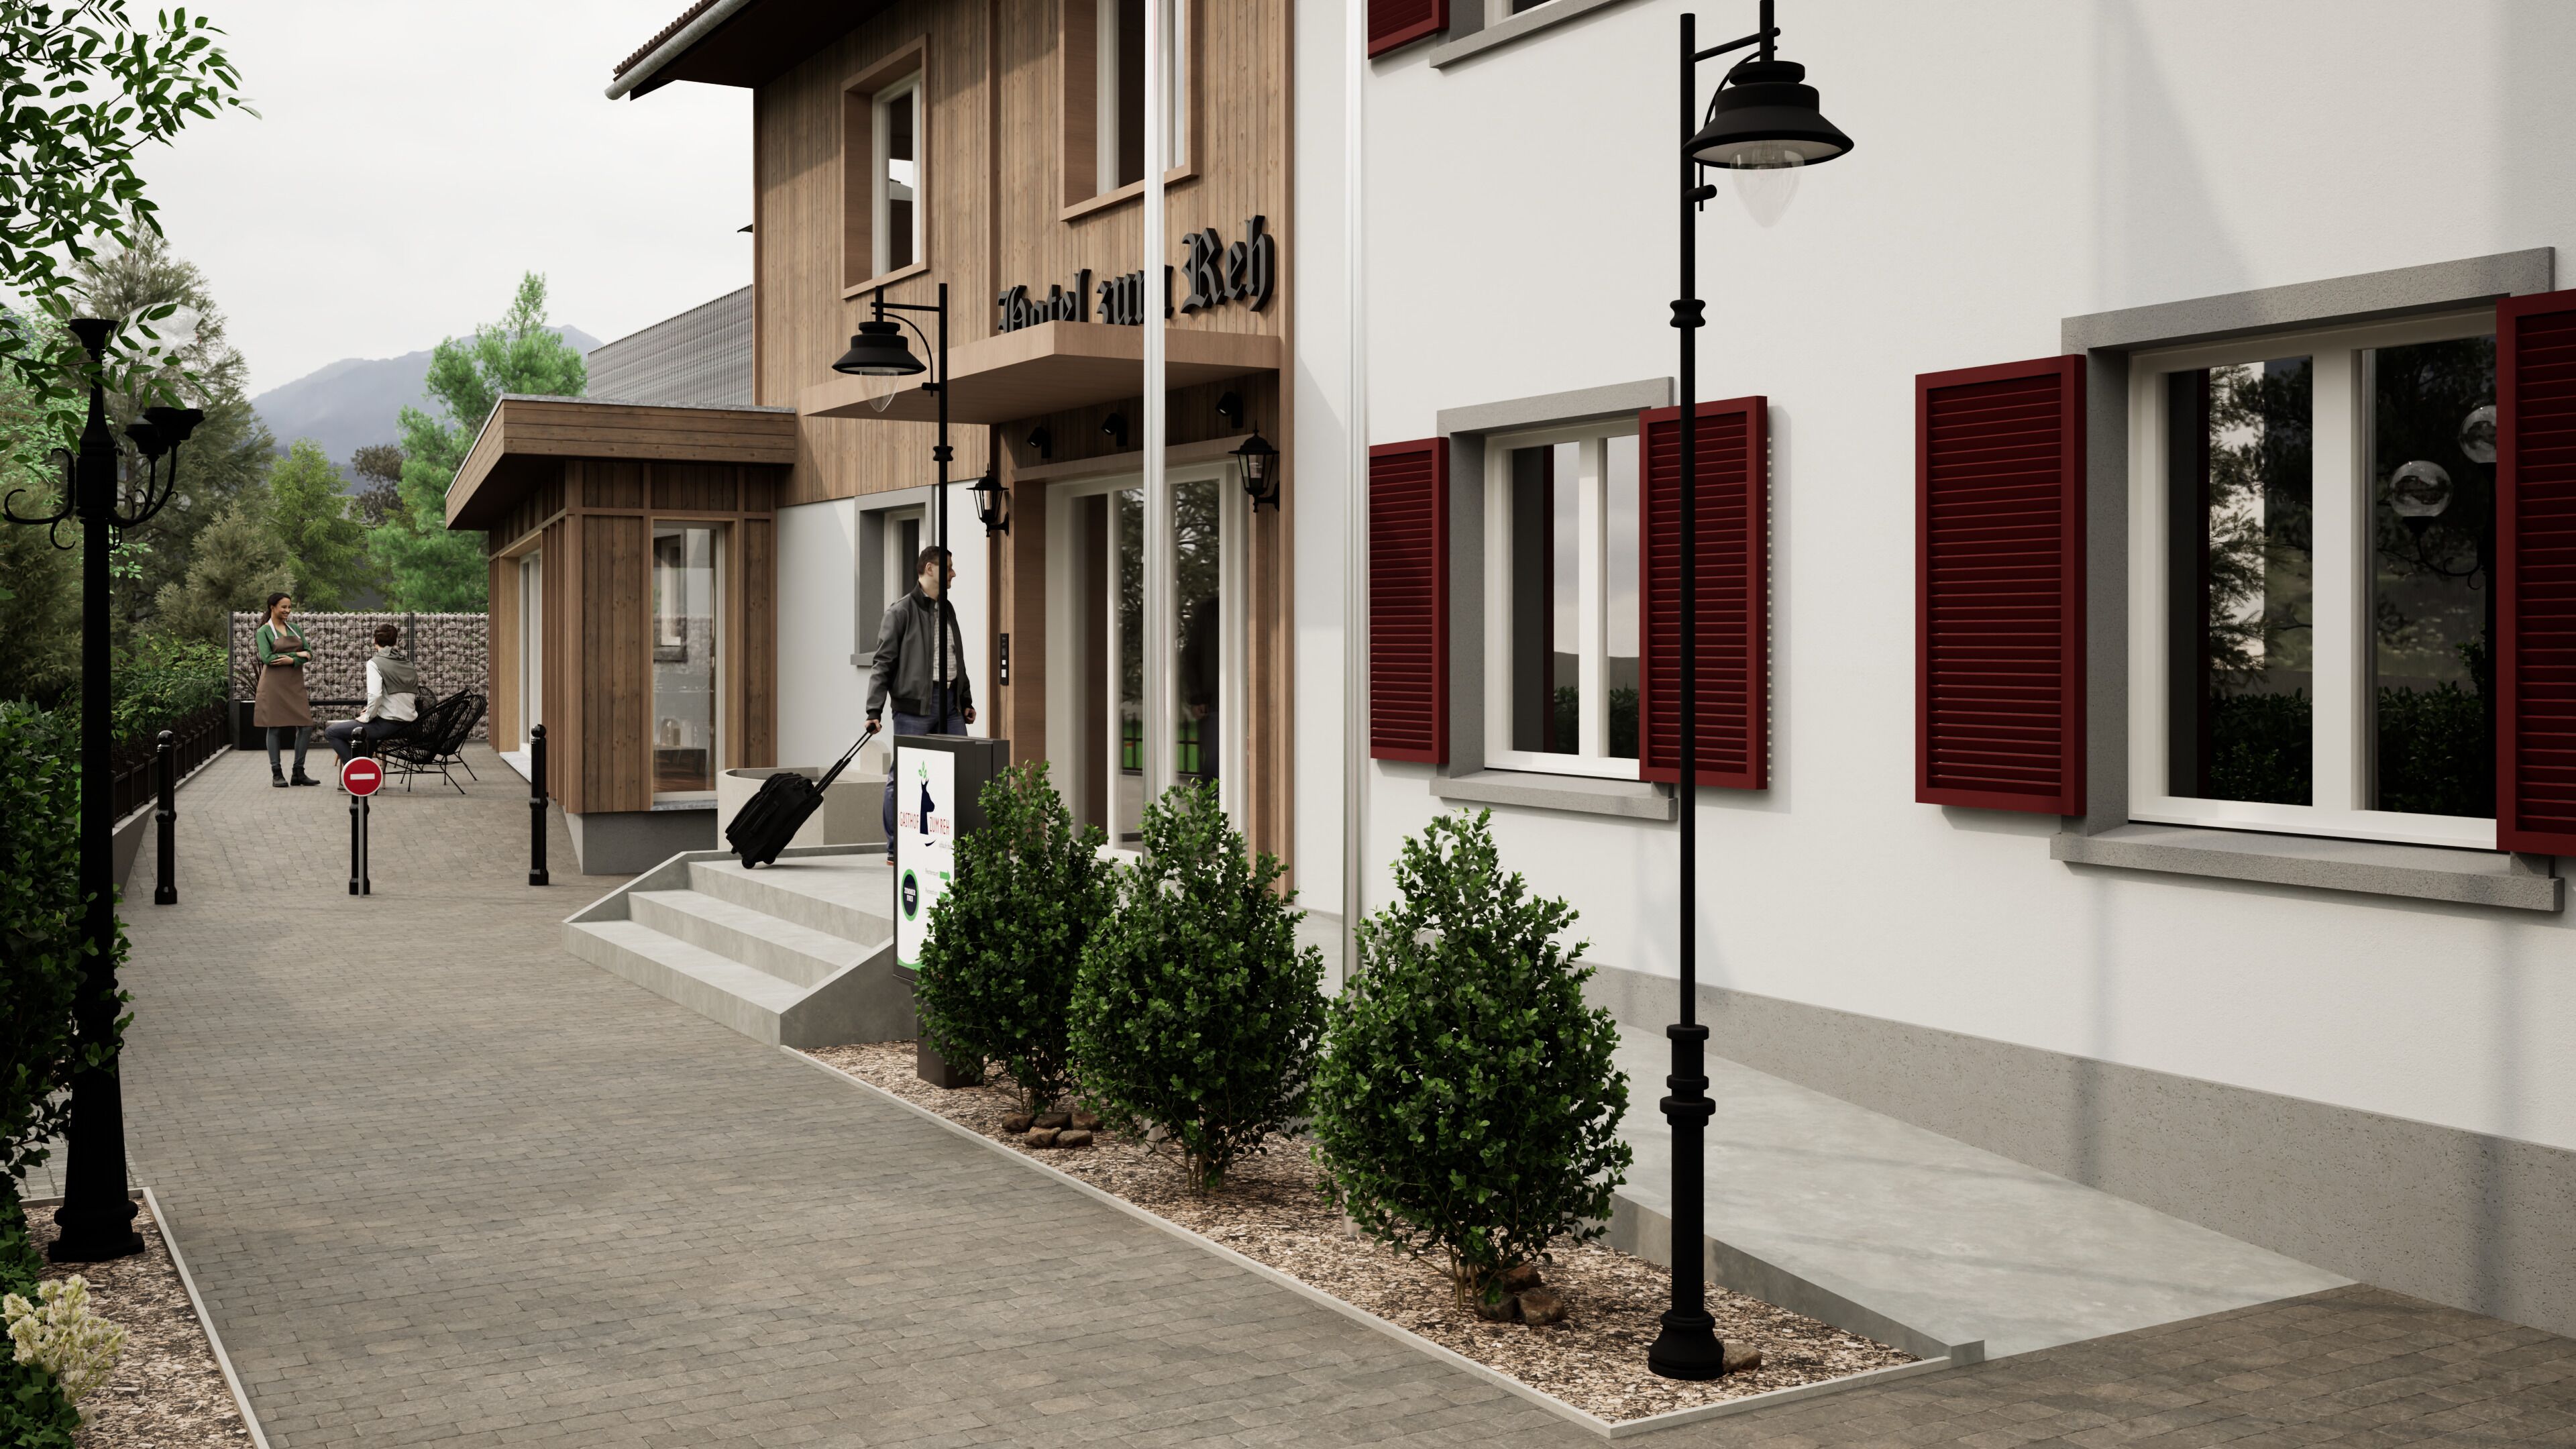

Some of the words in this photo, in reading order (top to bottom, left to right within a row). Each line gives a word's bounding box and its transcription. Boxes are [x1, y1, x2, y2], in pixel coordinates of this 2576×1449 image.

[998, 269, 1091, 333] Hotel
[1181, 215, 1275, 313] Reh
[900, 811, 919, 829] GASTHOF
[930, 816, 939, 833] ZUM
[940, 818, 950, 835] REH
